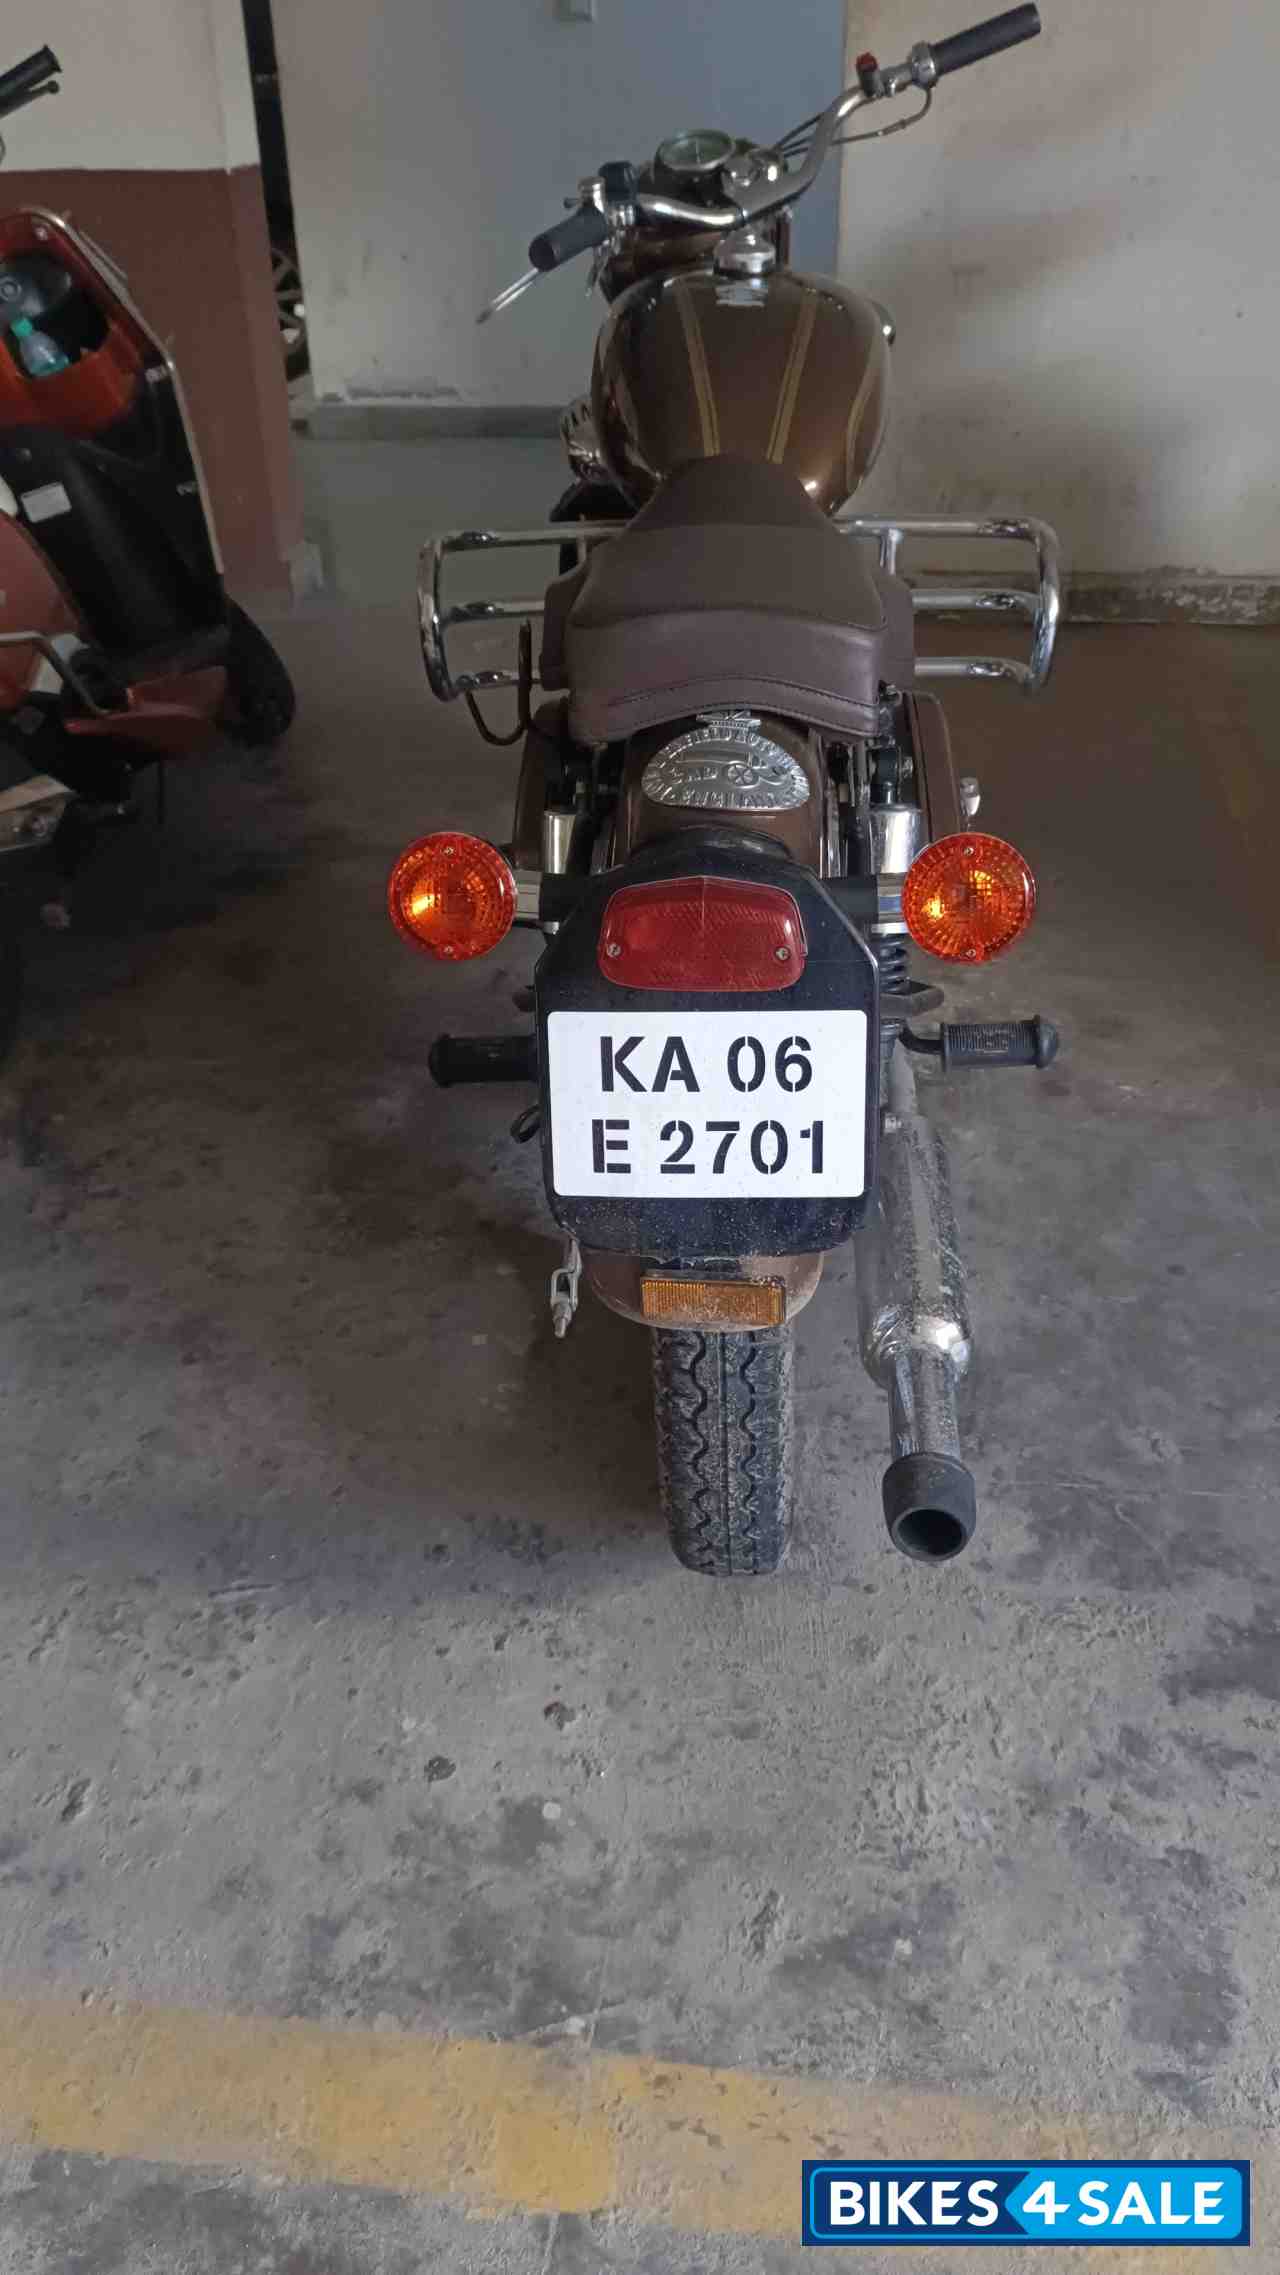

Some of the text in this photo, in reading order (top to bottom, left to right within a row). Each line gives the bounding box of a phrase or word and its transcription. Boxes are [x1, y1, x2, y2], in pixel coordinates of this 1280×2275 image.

[600, 1036, 812, 1092] KA 06
[592, 1119, 823, 1174] E 2701
